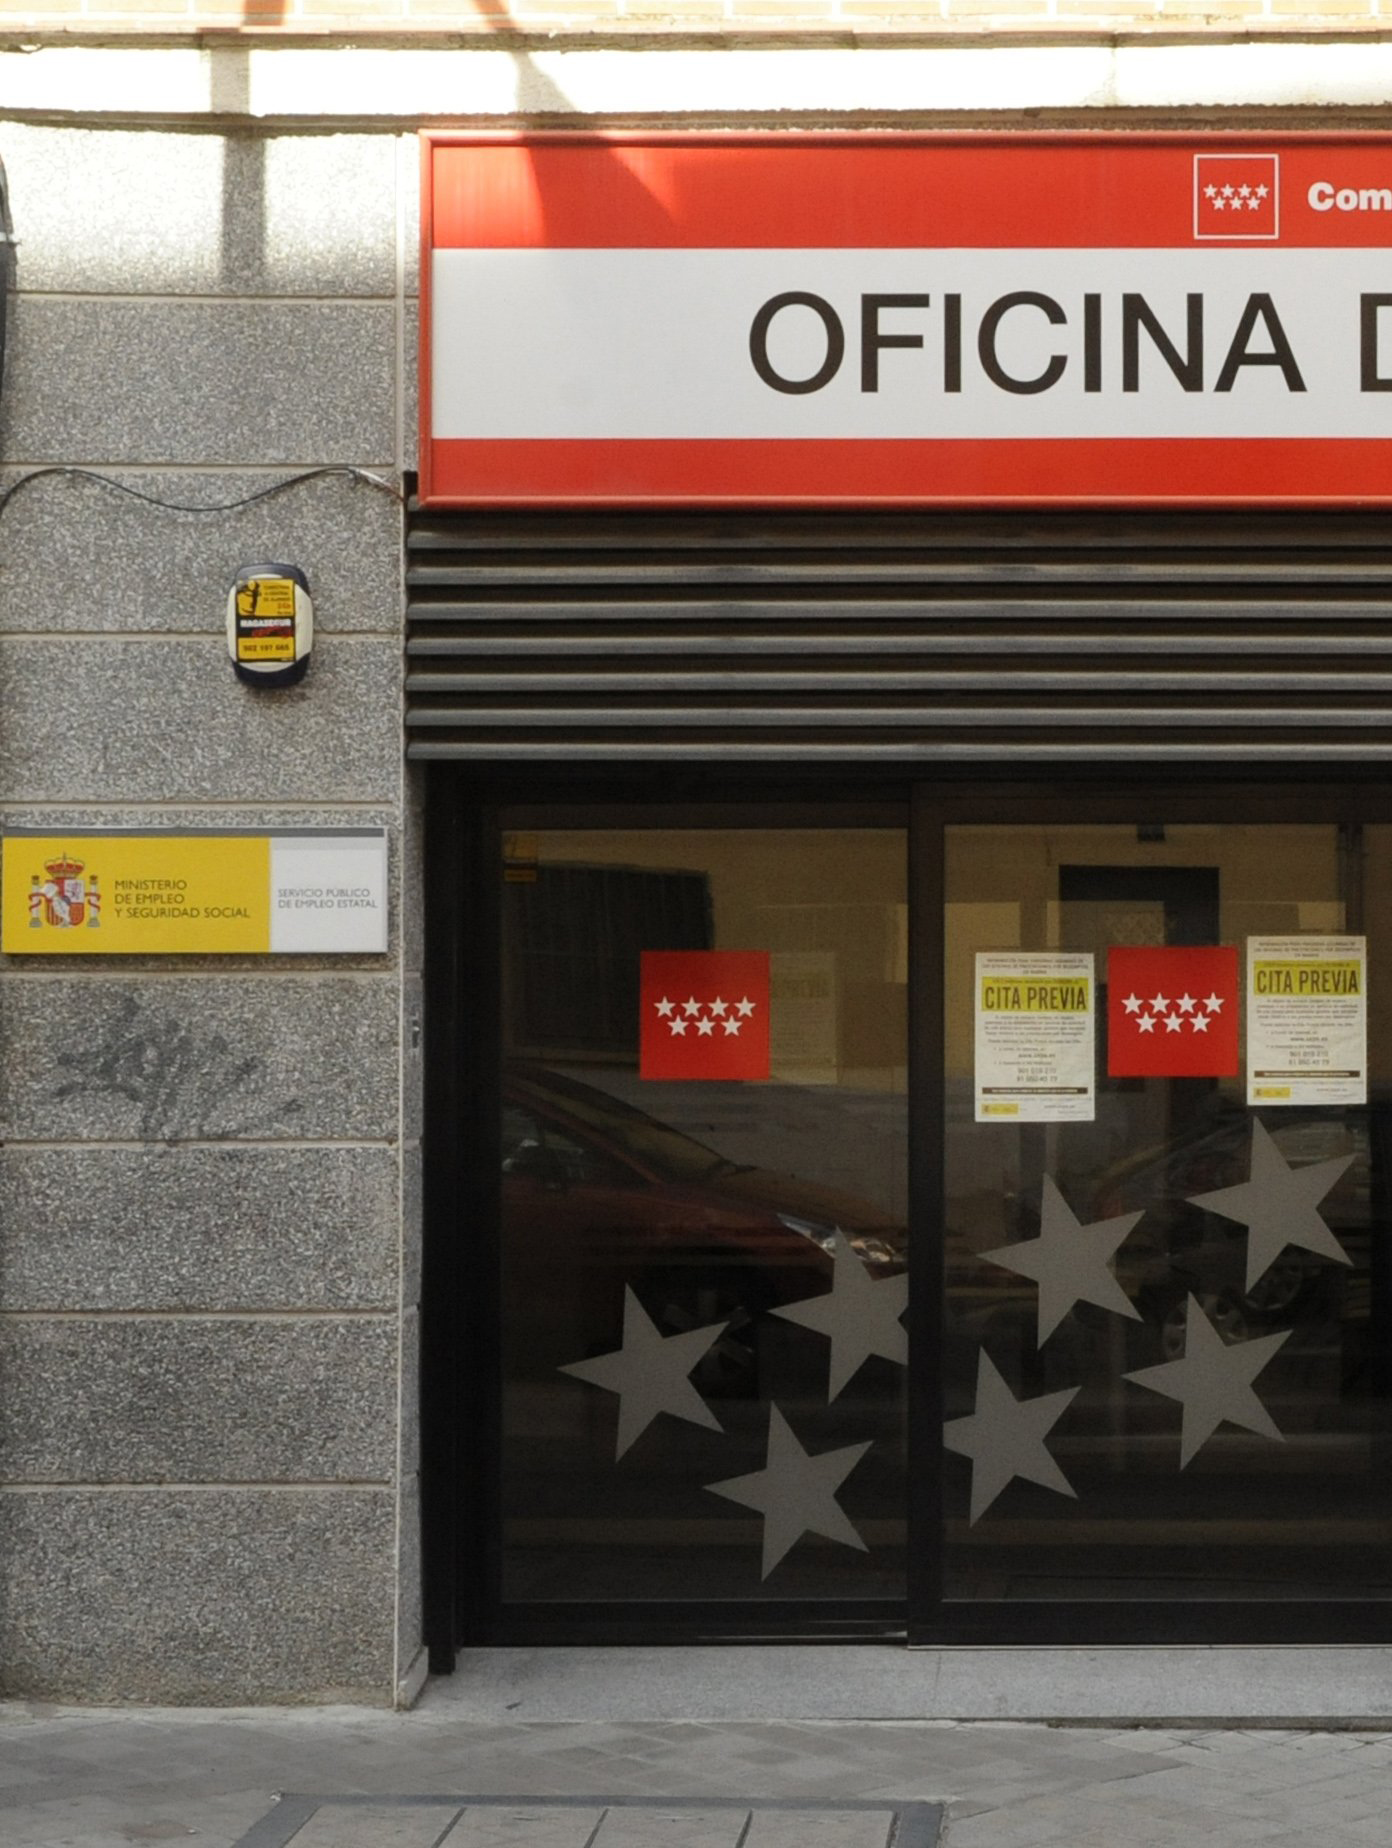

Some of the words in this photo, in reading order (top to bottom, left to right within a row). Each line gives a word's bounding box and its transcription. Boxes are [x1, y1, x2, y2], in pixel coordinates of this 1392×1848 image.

[750, 292, 1306, 394] OFICINA
[114, 879, 188, 891] MINISTERIO
[278, 888, 324, 898] SERVICIO
[325, 886, 371, 898] PÚBLICO
[114, 893, 131, 905] DE
[135, 893, 185, 905] EMPLEO
[278, 899, 292, 909] DE
[294, 899, 333, 909] EMPLEO
[337, 899, 379, 909] ESTATAL
[114, 907, 123, 918] Y
[127, 906, 200, 918] SEGURIDAD
[203, 906, 250, 918] SOCIAL
[1256, 969, 1293, 993] CITA
[1298, 969, 1359, 993] PREVIA
[985, 986, 1021, 1009] CITA
[1027, 986, 1087, 1010] PREVIA
